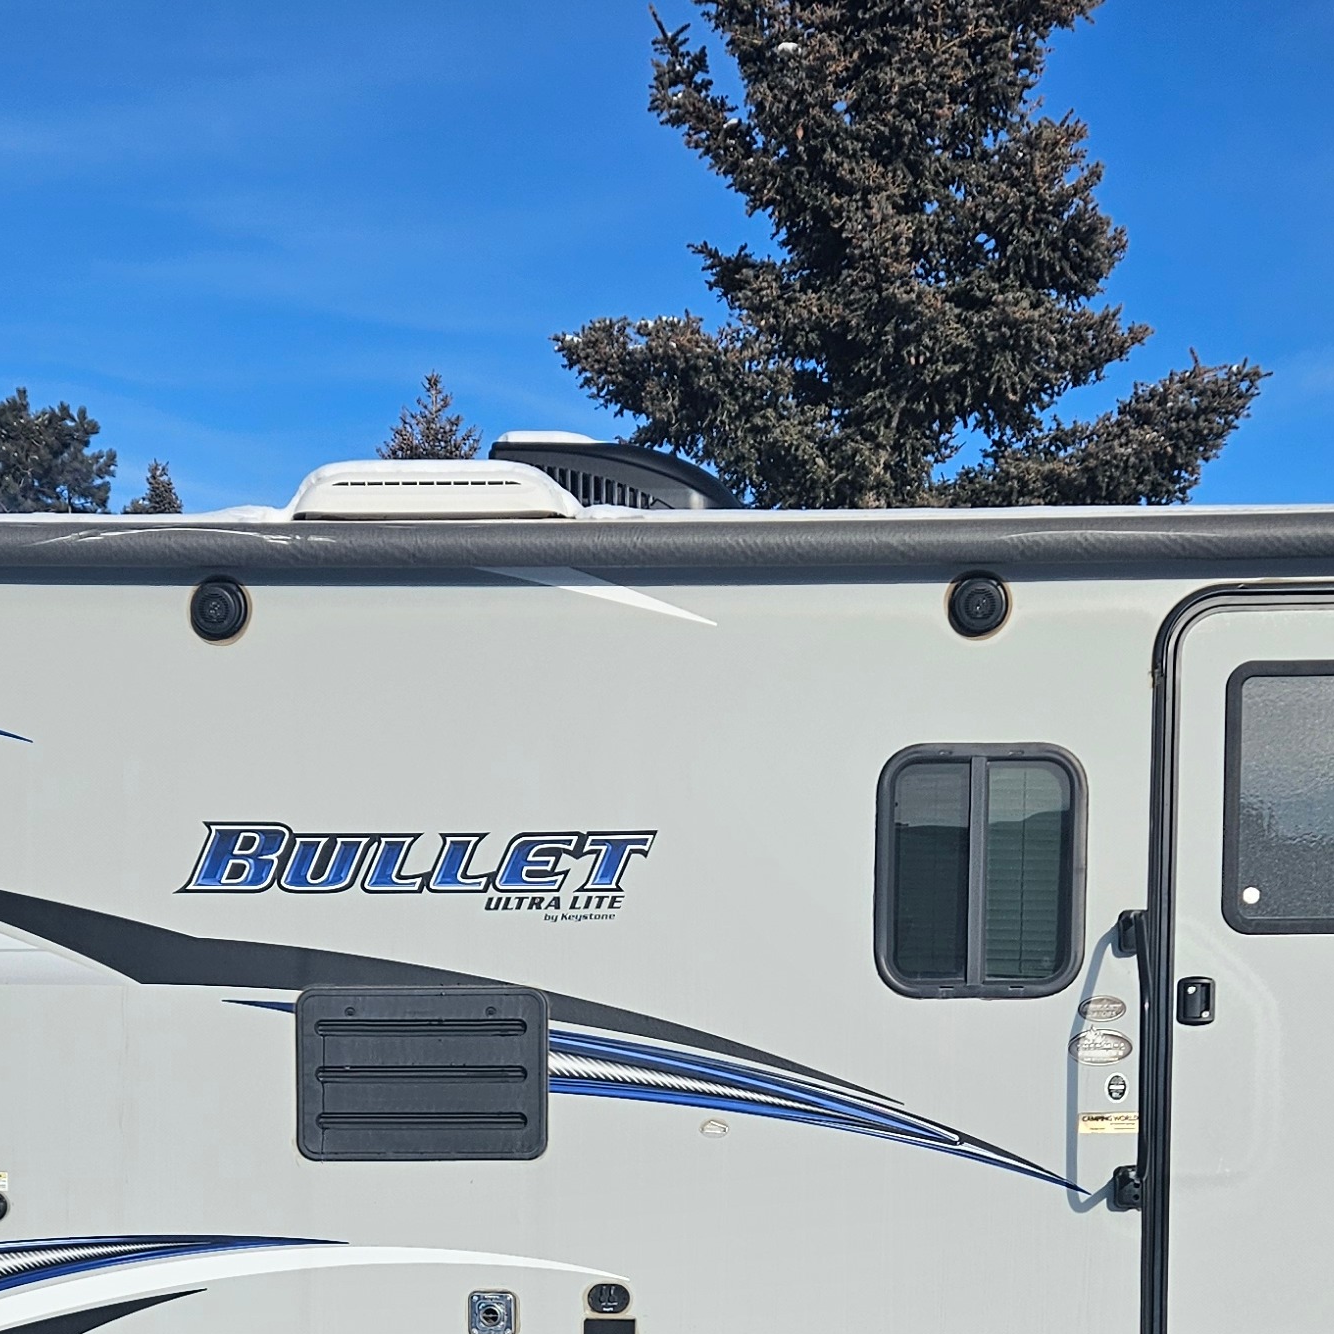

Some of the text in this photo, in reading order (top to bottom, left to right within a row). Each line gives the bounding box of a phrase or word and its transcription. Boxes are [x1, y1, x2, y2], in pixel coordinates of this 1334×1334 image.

[174, 821, 658, 894] BULLET
[484, 895, 625, 911] ULTRA LITE
[544, 913, 616, 922] by Keystone
